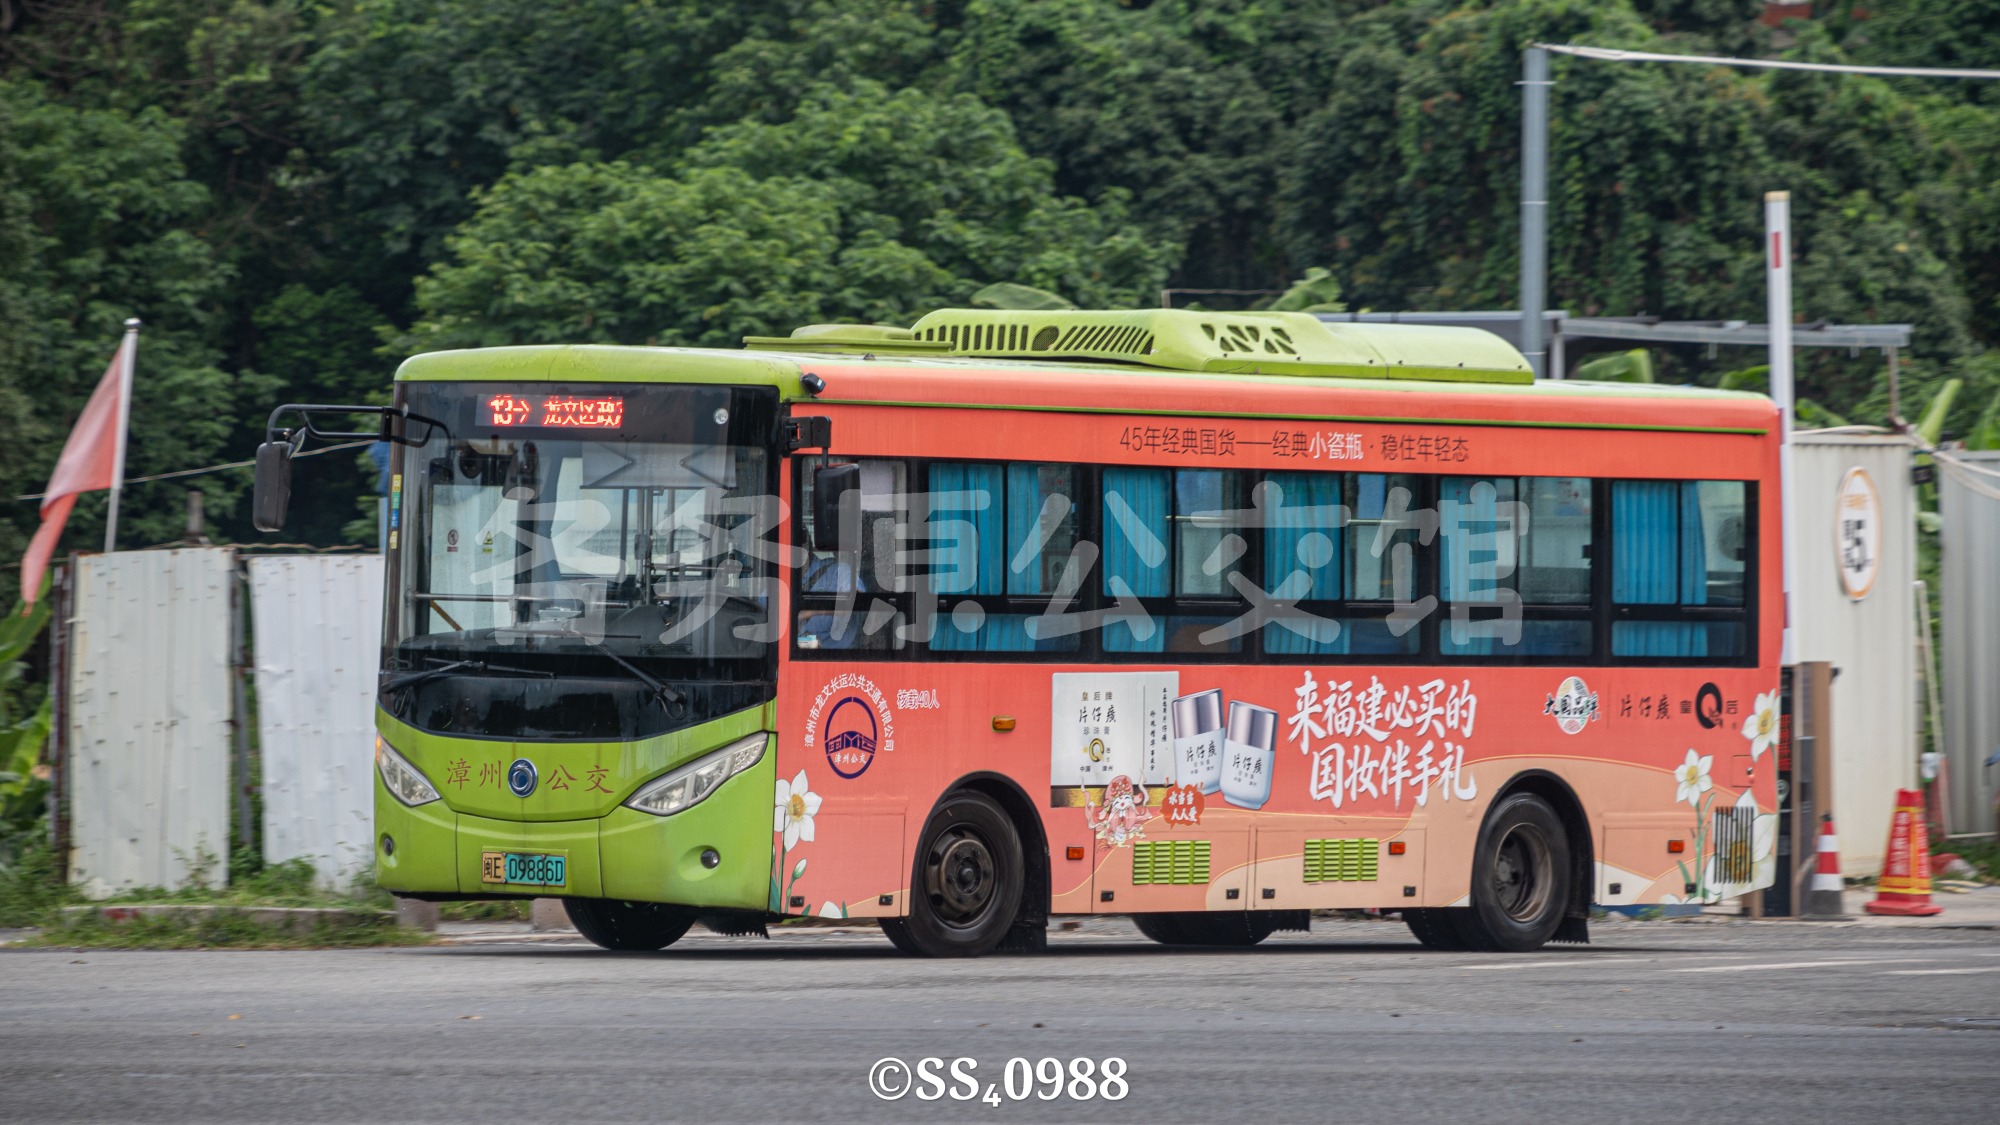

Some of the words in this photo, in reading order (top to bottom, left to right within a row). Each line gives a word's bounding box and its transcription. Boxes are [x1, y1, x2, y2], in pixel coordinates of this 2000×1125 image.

[804, 673, 894, 751] 漳州市龙文长运公共交通有限公司
[1287, 670, 1477, 755] 来福建必买的
[1309, 739, 1478, 809] 国妆伴手礼
[1171, 806, 1198, 822] 人人爱
